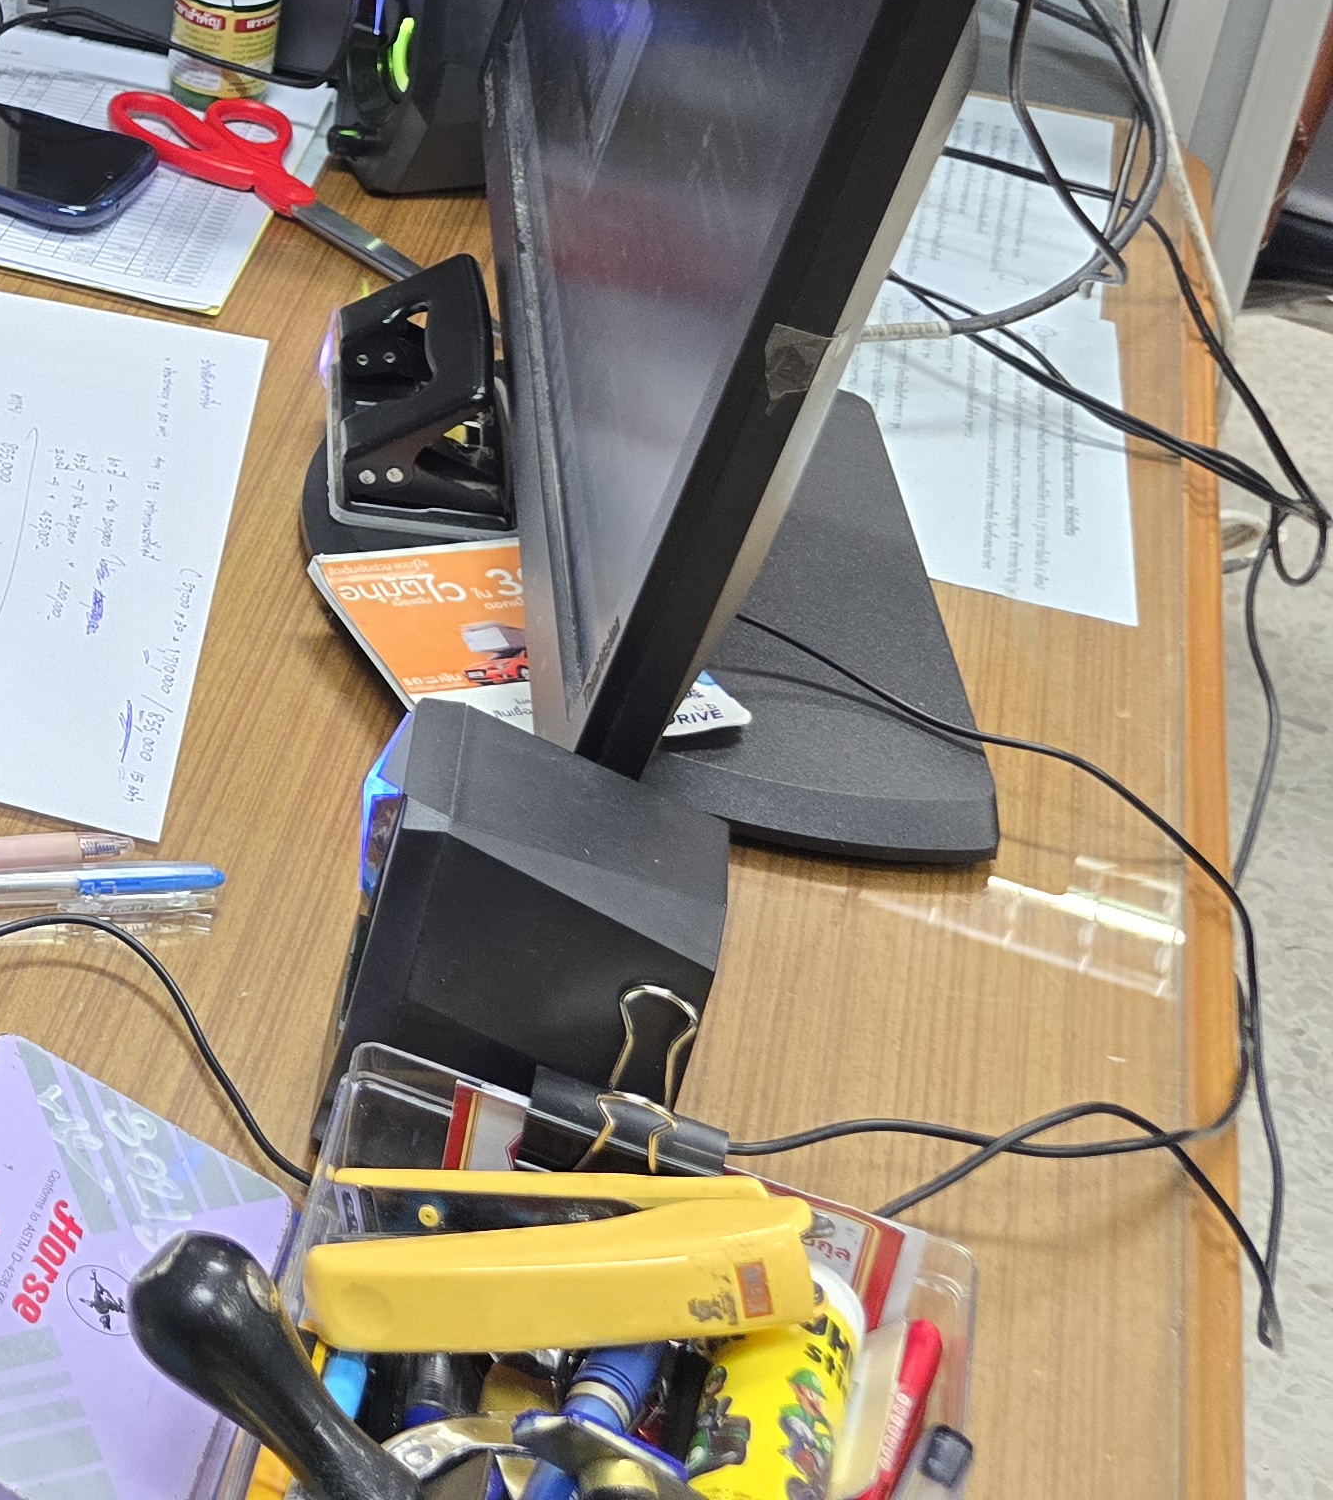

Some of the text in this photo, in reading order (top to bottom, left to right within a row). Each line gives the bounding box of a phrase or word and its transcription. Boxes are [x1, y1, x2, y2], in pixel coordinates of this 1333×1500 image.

[484, 566, 524, 596] 3
[35, 1170, 61, 1208] Conforms
[16, 1223, 35, 1252] ASTM
[11, 1198, 85, 1323] Horse
